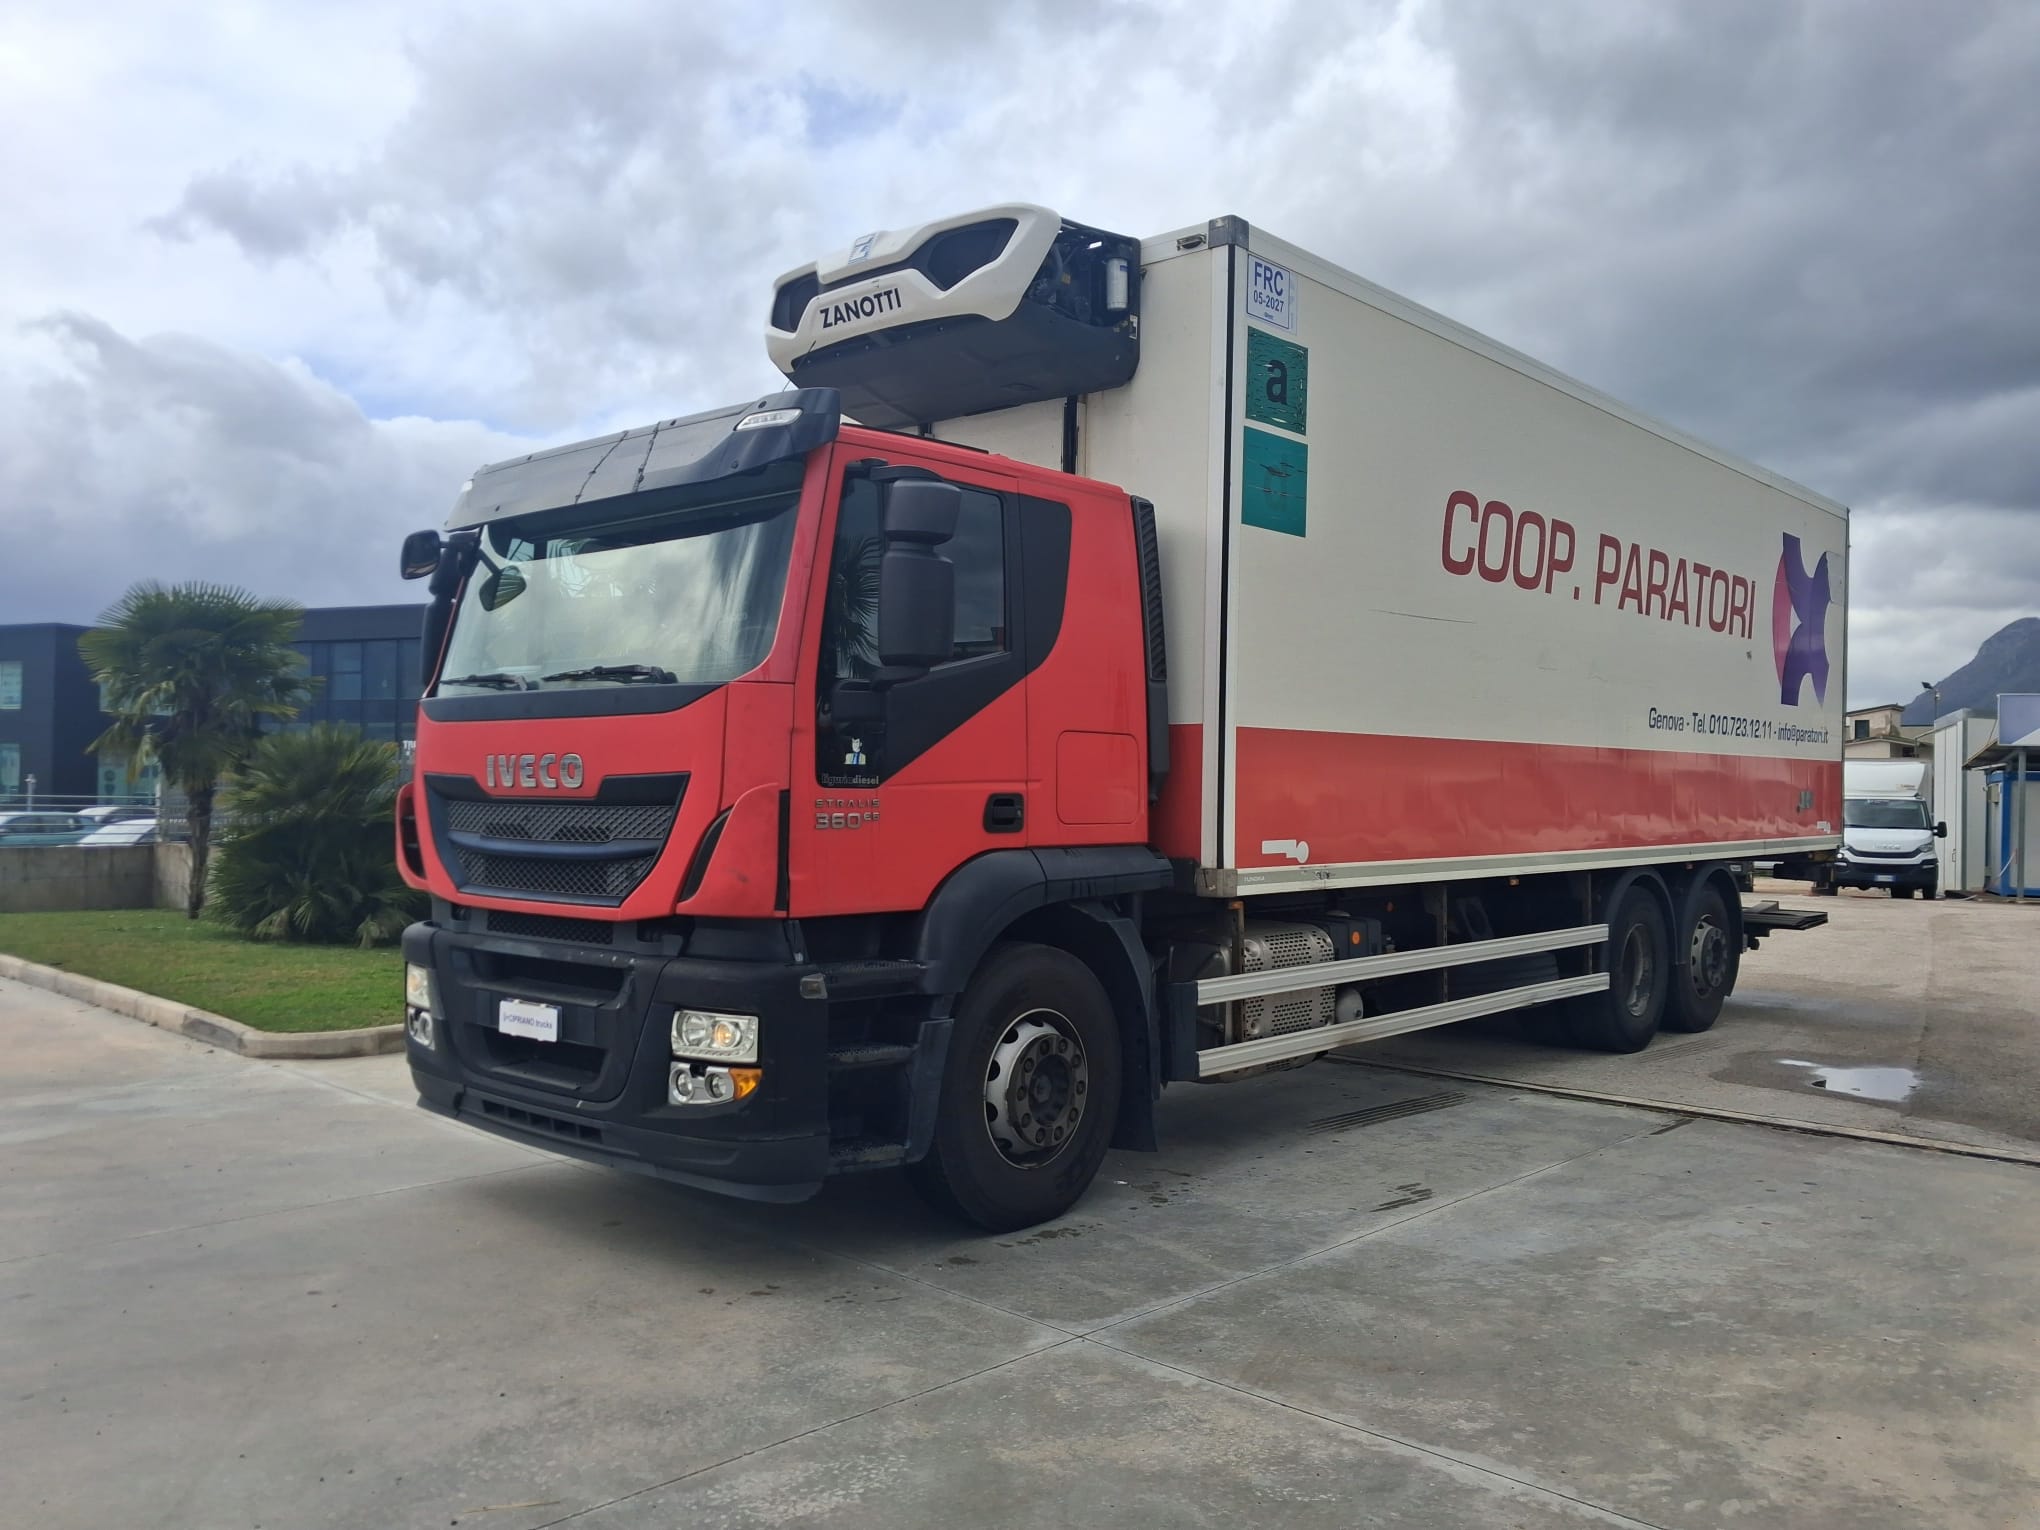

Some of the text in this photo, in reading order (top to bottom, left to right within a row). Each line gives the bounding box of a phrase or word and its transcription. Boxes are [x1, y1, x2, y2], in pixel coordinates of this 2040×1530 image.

[1254, 261, 1284, 297] FRC
[820, 287, 902, 329] ZANOTTI
[1253, 289, 1285, 313] 05-2027
[1266, 359, 1288, 405] a
[1441, 489, 1757, 640] COOP. PARATORI
[1649, 706, 1684, 732] Genova
[1692, 712, 1707, 734] Tel.
[1709, 714, 1772, 740] 010.723.12.11
[1777, 722, 1829, 746] info@paratori.it
[486, 753, 584, 789] IVECO
[815, 799, 880, 808] STRALIS
[815, 812, 862, 829] 360
